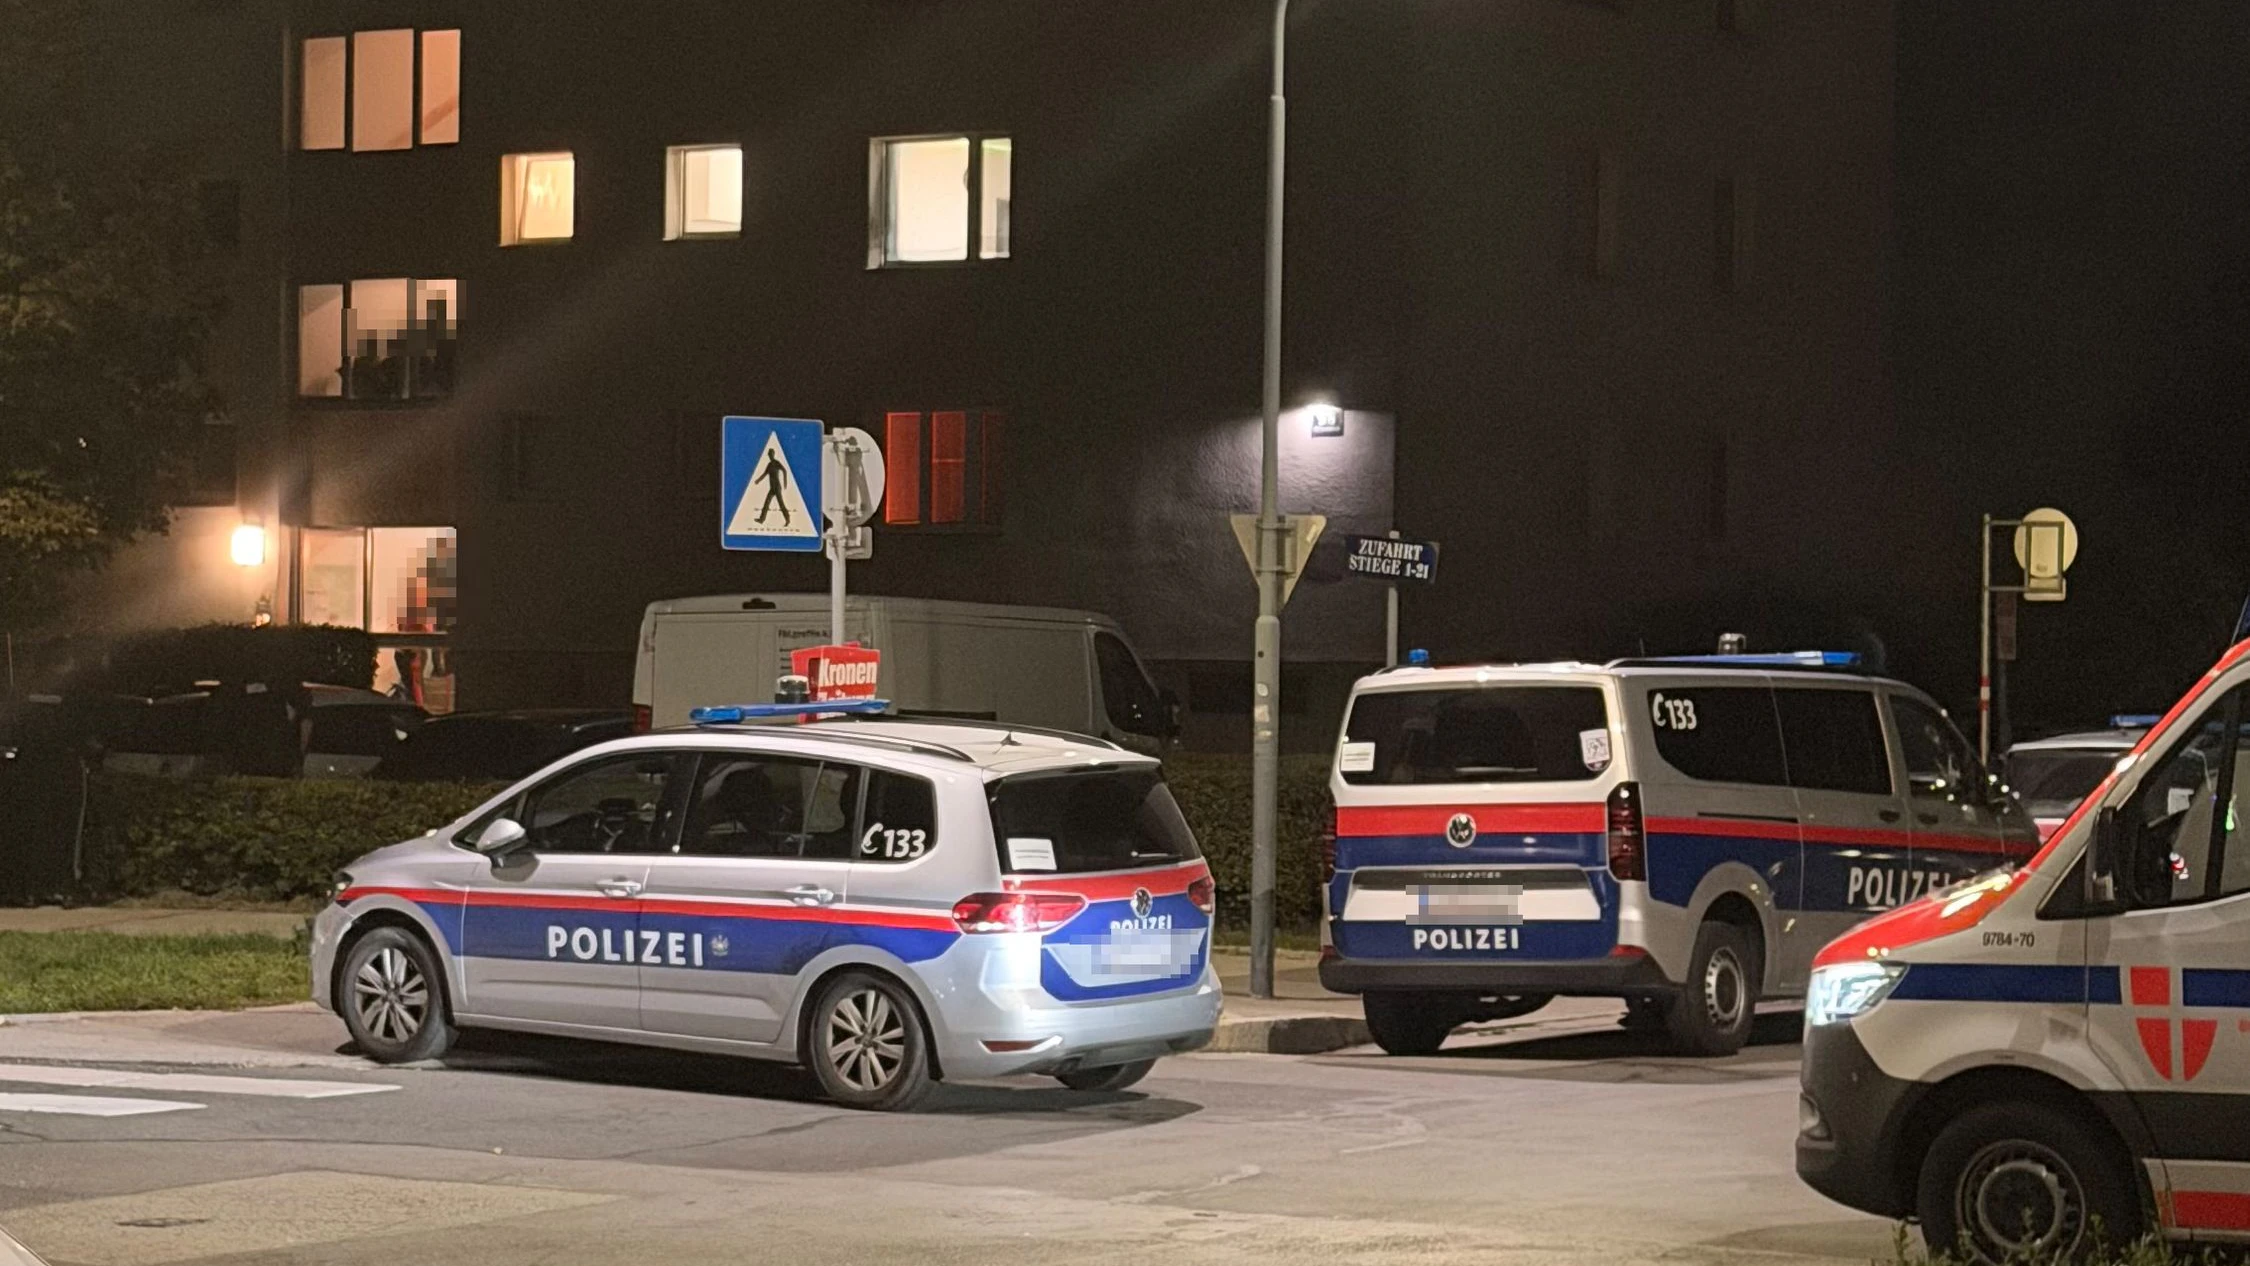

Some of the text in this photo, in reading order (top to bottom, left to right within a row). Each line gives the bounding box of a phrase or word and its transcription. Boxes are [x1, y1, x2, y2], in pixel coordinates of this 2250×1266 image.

[1359, 539, 1423, 561] ZUFAHRT
[1349, 554, 1430, 579] STIEGE 1-21
[818, 658, 878, 687] Kronen
[1664, 699, 1697, 730] 133
[884, 828, 926, 858] 133
[547, 925, 704, 967] POLIZEI
[1413, 928, 1519, 950] POLIZEI
